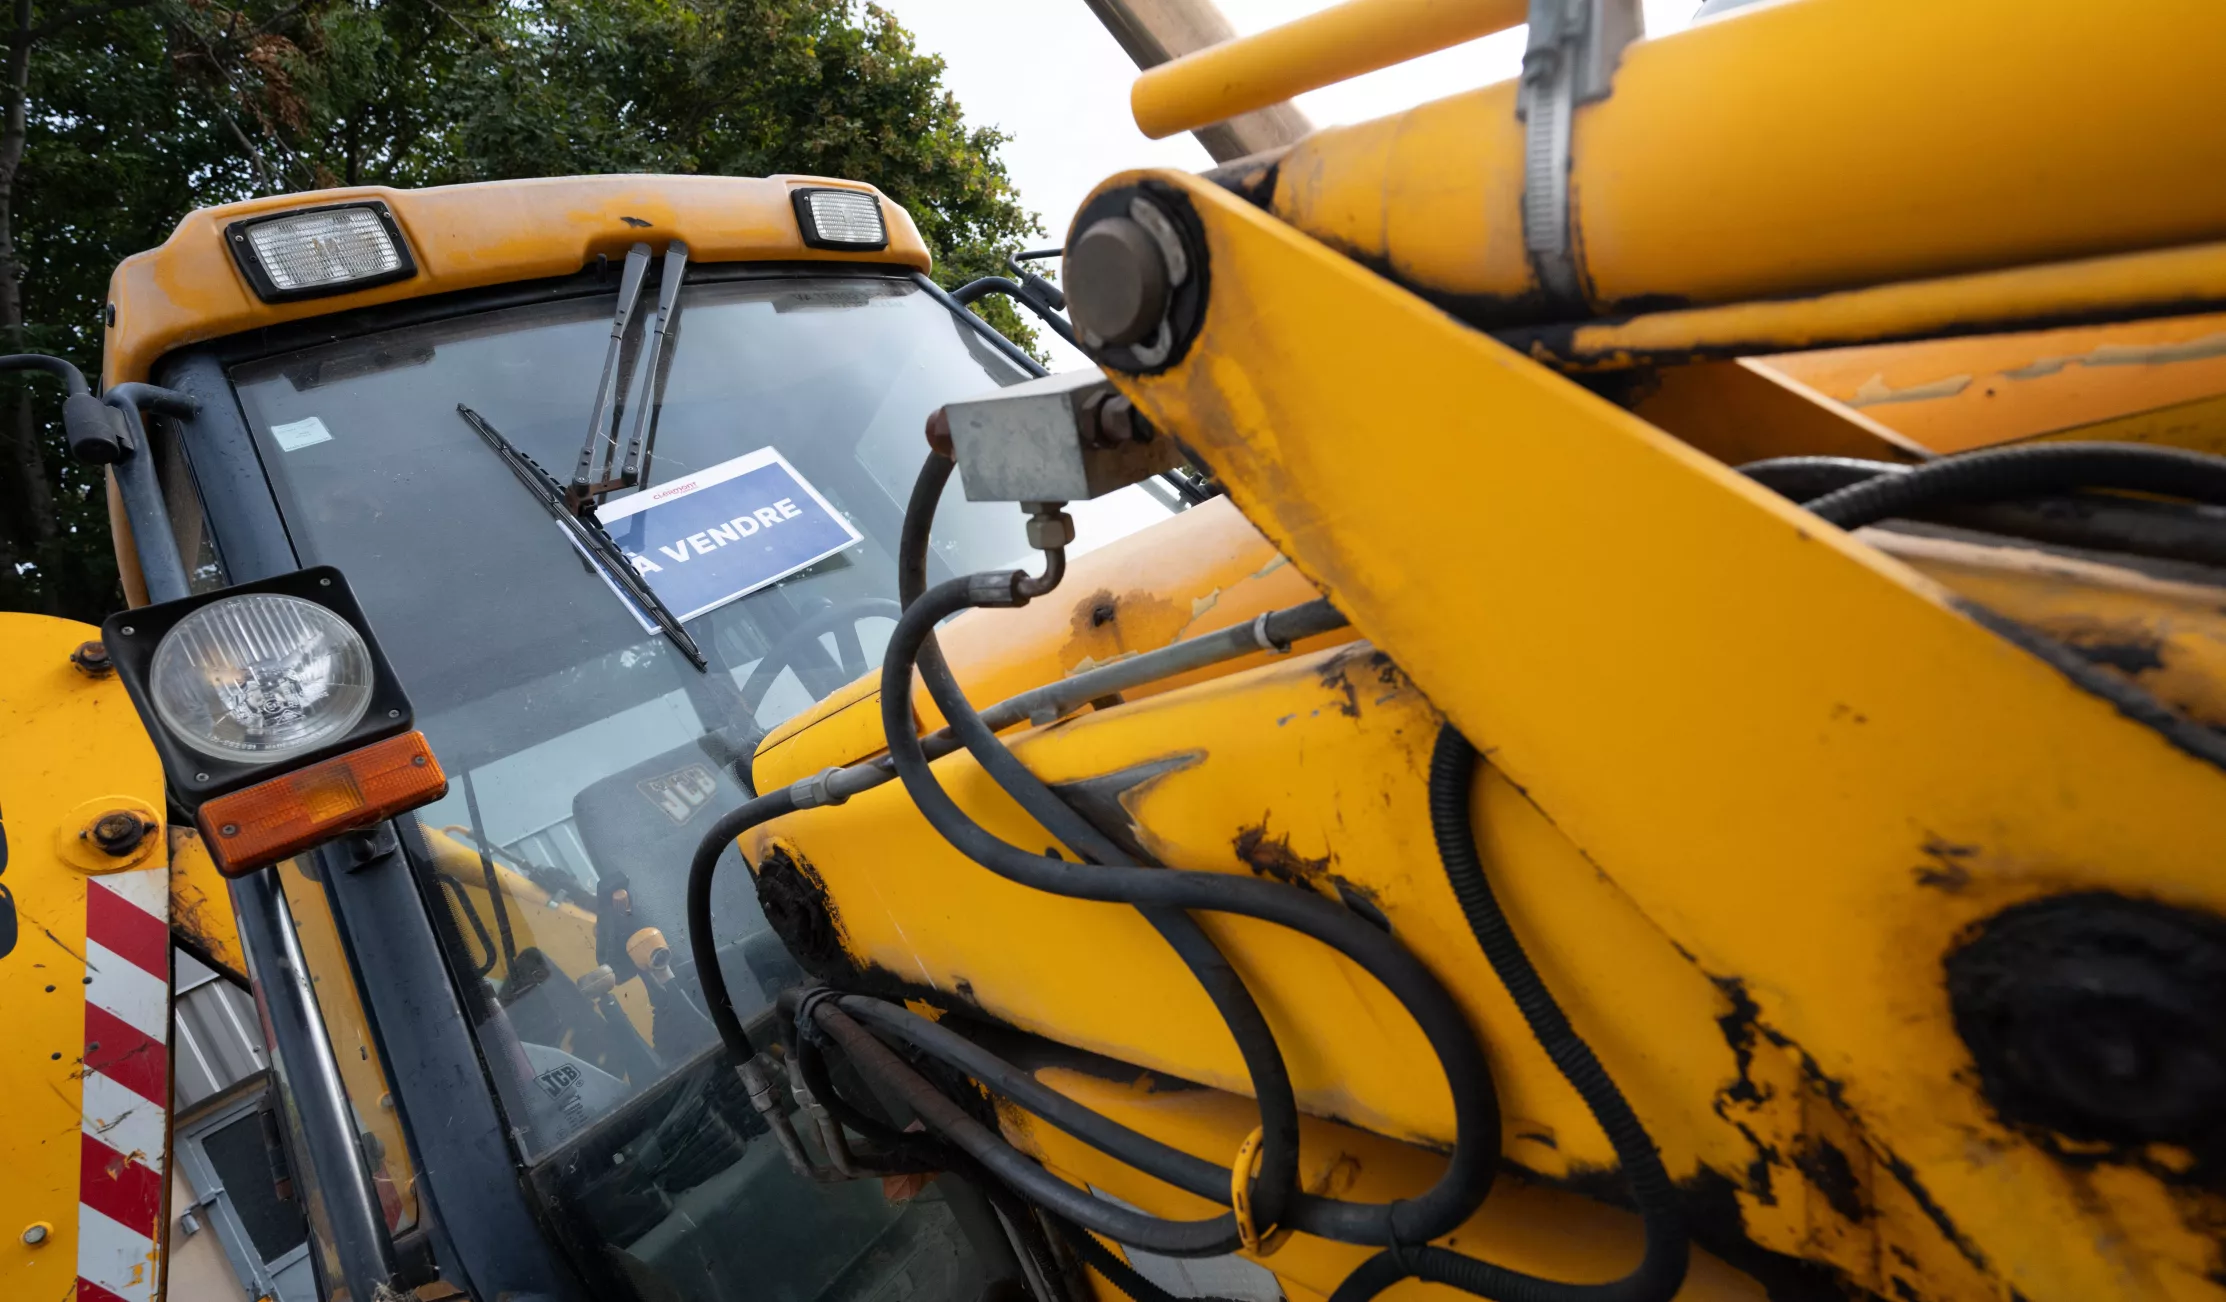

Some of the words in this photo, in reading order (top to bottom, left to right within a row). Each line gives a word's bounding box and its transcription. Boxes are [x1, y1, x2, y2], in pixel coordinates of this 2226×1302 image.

[658, 497, 803, 563] VENDRE
[648, 766, 716, 820] JCB
[541, 1066, 577, 1098] JCB
